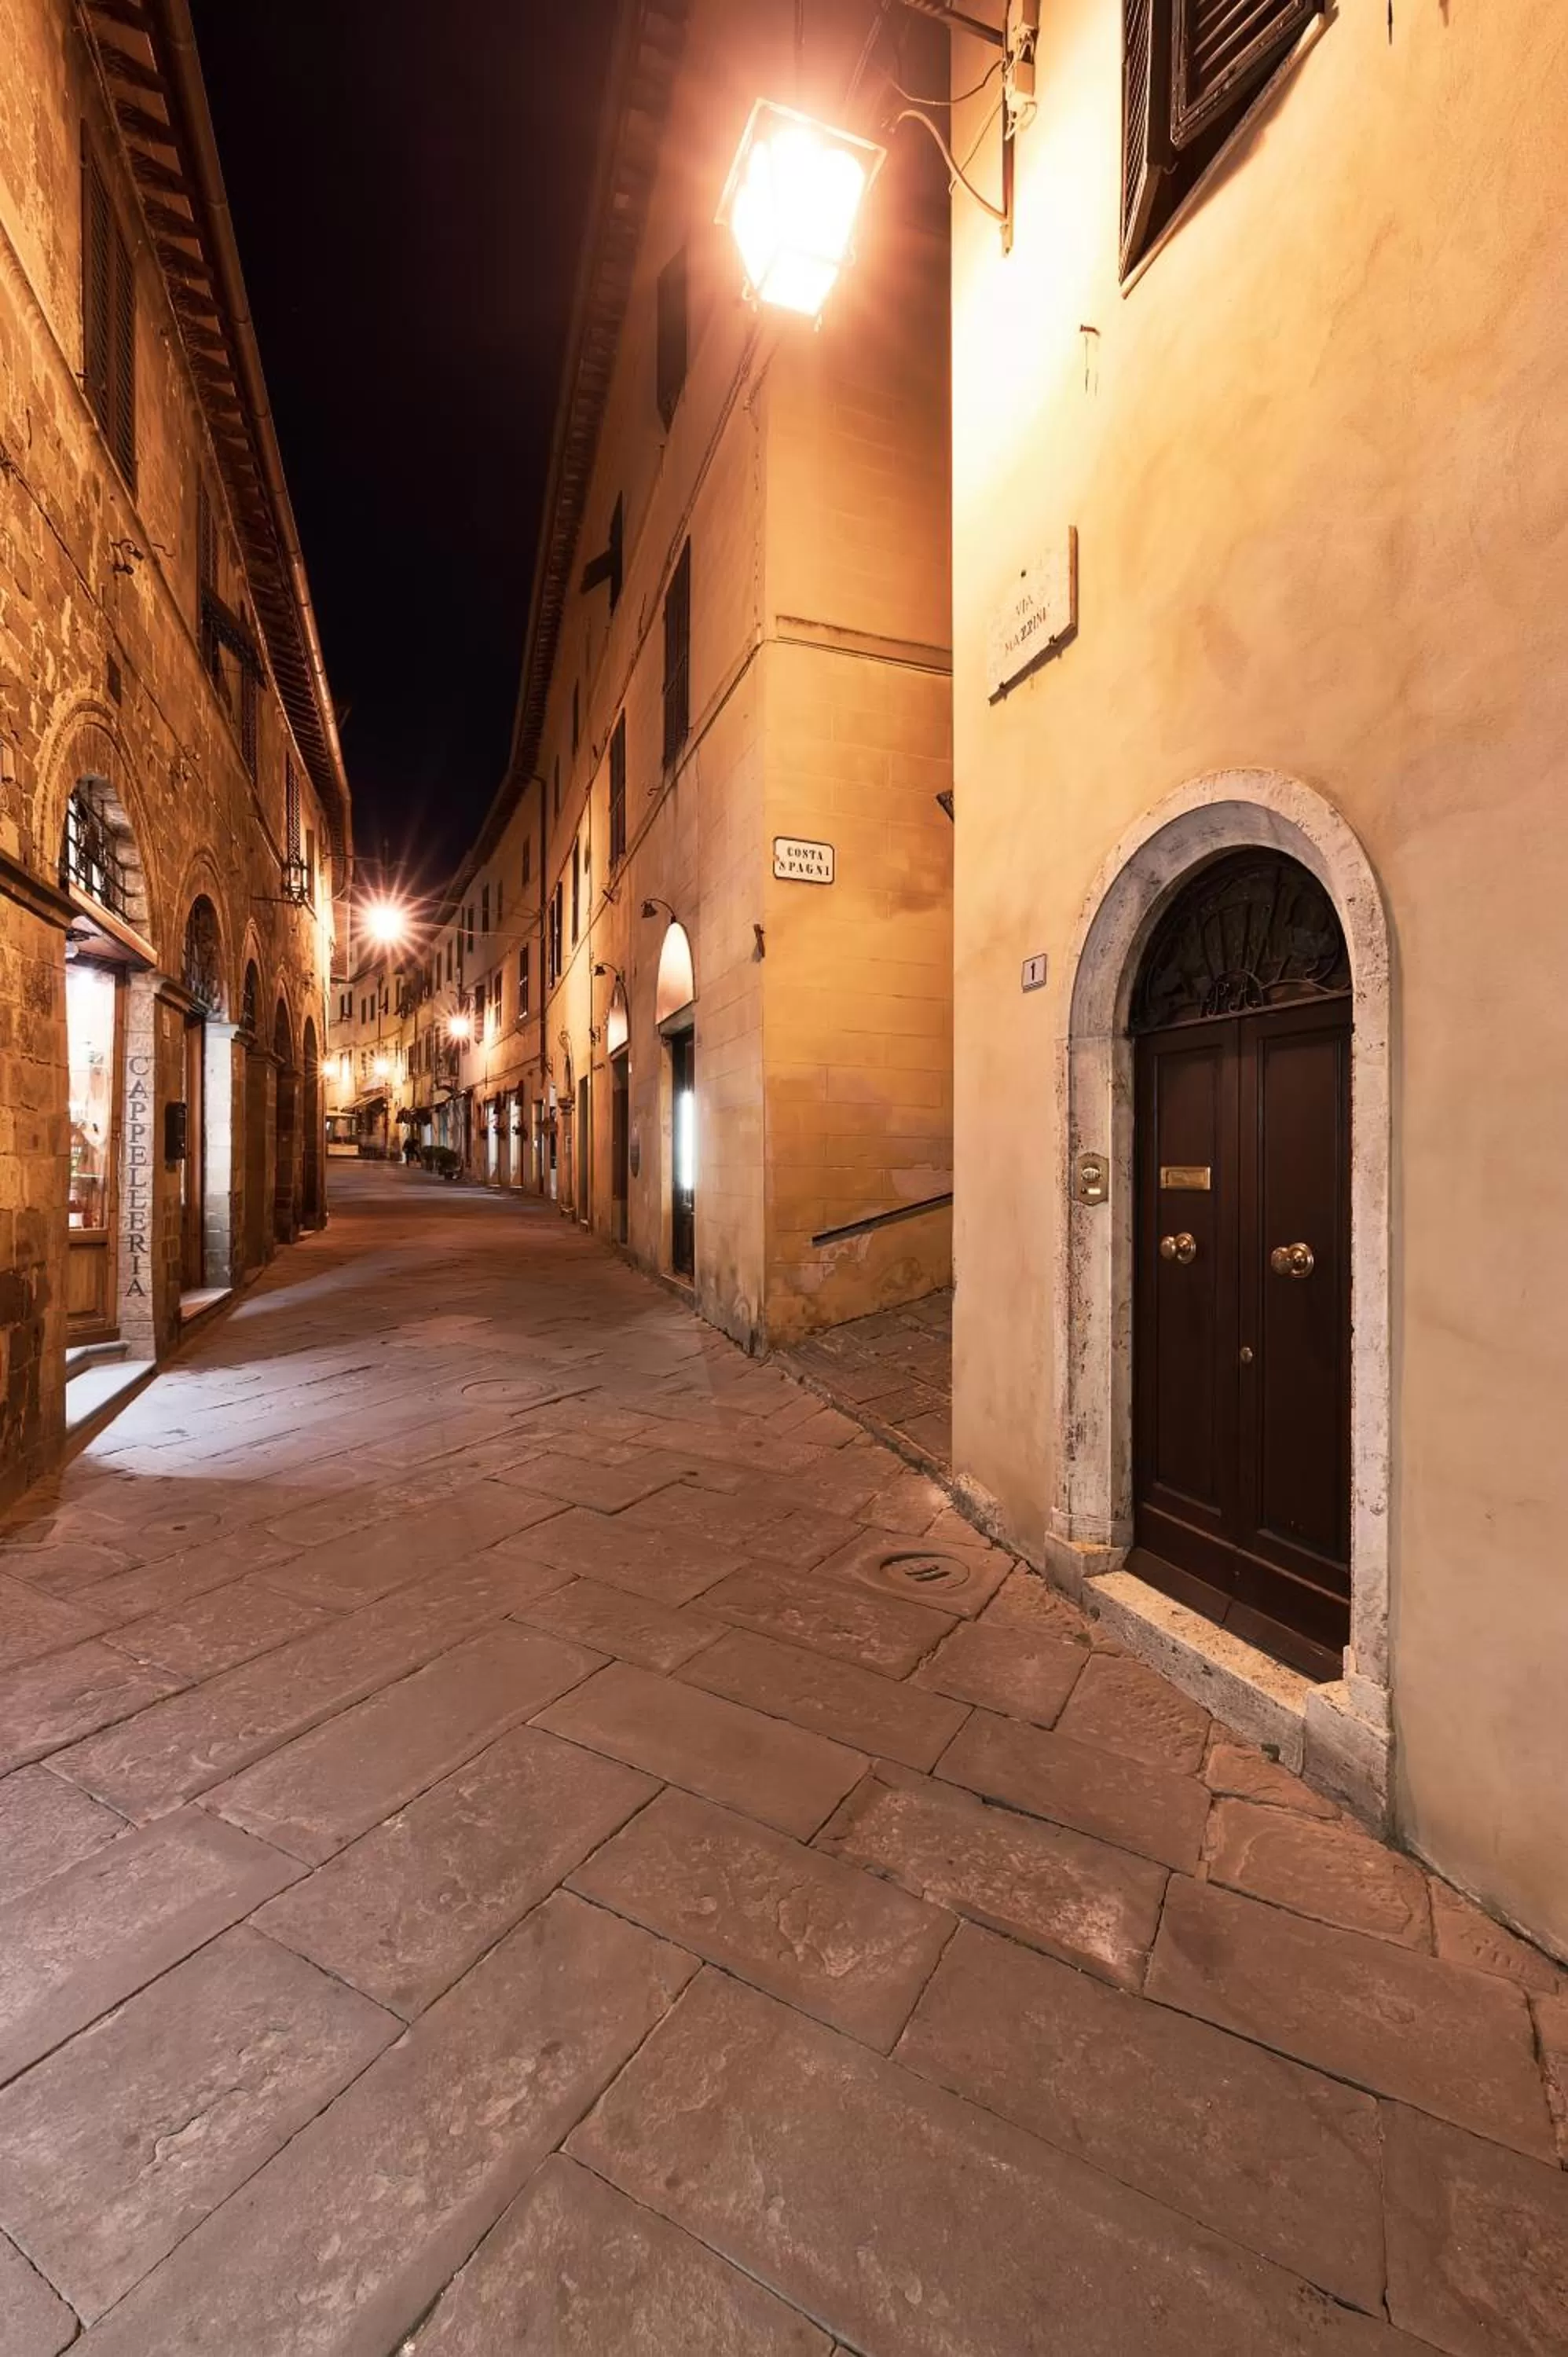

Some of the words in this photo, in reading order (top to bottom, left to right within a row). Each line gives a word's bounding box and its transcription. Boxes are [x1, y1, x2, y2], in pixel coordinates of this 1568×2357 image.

[1015, 595, 1033, 616] VIA
[1005, 606, 1046, 657] MAZZINI
[787, 846, 823, 861] COSTA
[779, 861, 830, 876] SPAGNI
[1031, 962, 1036, 981] 1
[126, 1055, 150, 1297] CAPPELLERIA
